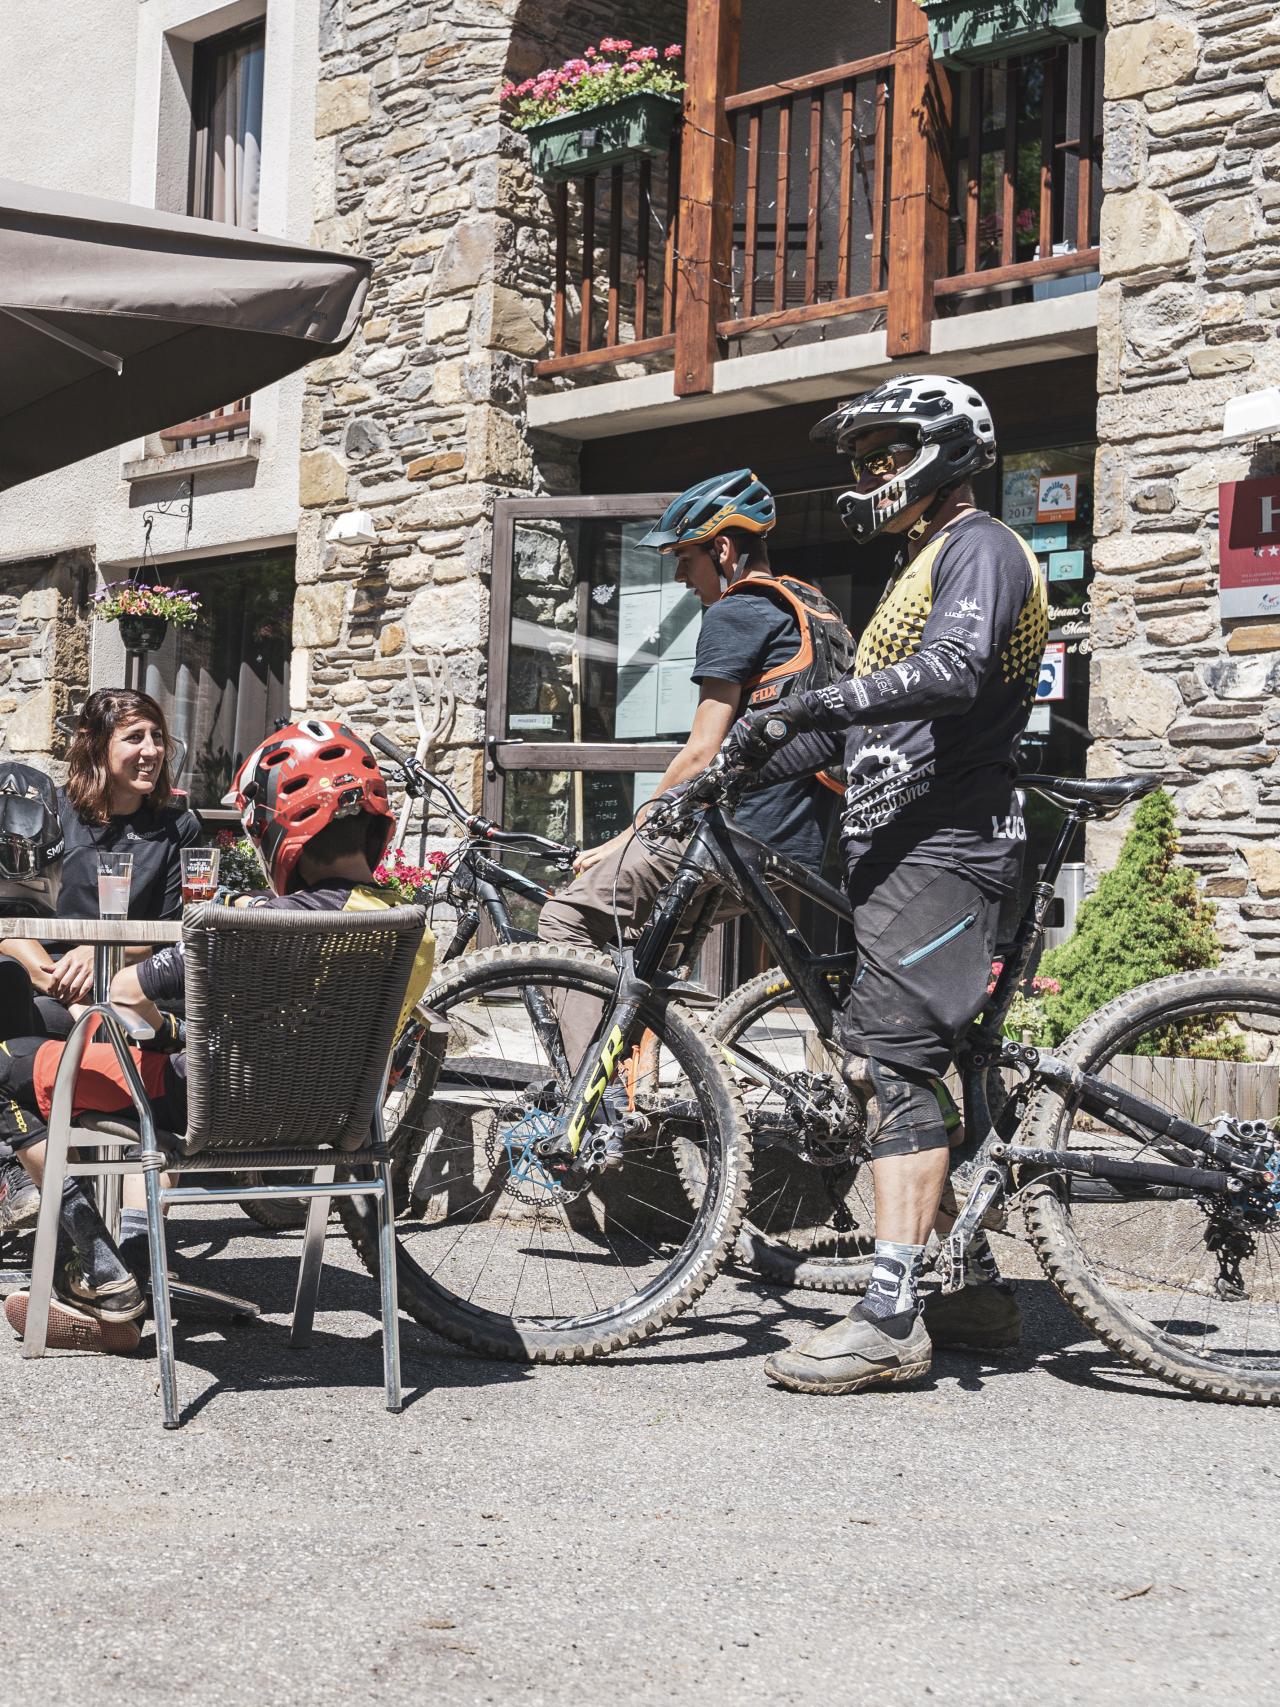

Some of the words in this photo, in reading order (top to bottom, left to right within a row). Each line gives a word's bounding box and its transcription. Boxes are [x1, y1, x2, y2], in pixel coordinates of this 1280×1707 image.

[751, 684, 778, 704] FOX
[710, 1168, 738, 1244] MICHELIN
[680, 1249, 713, 1288] WILD
[627, 1285, 681, 1325] ENDURO
